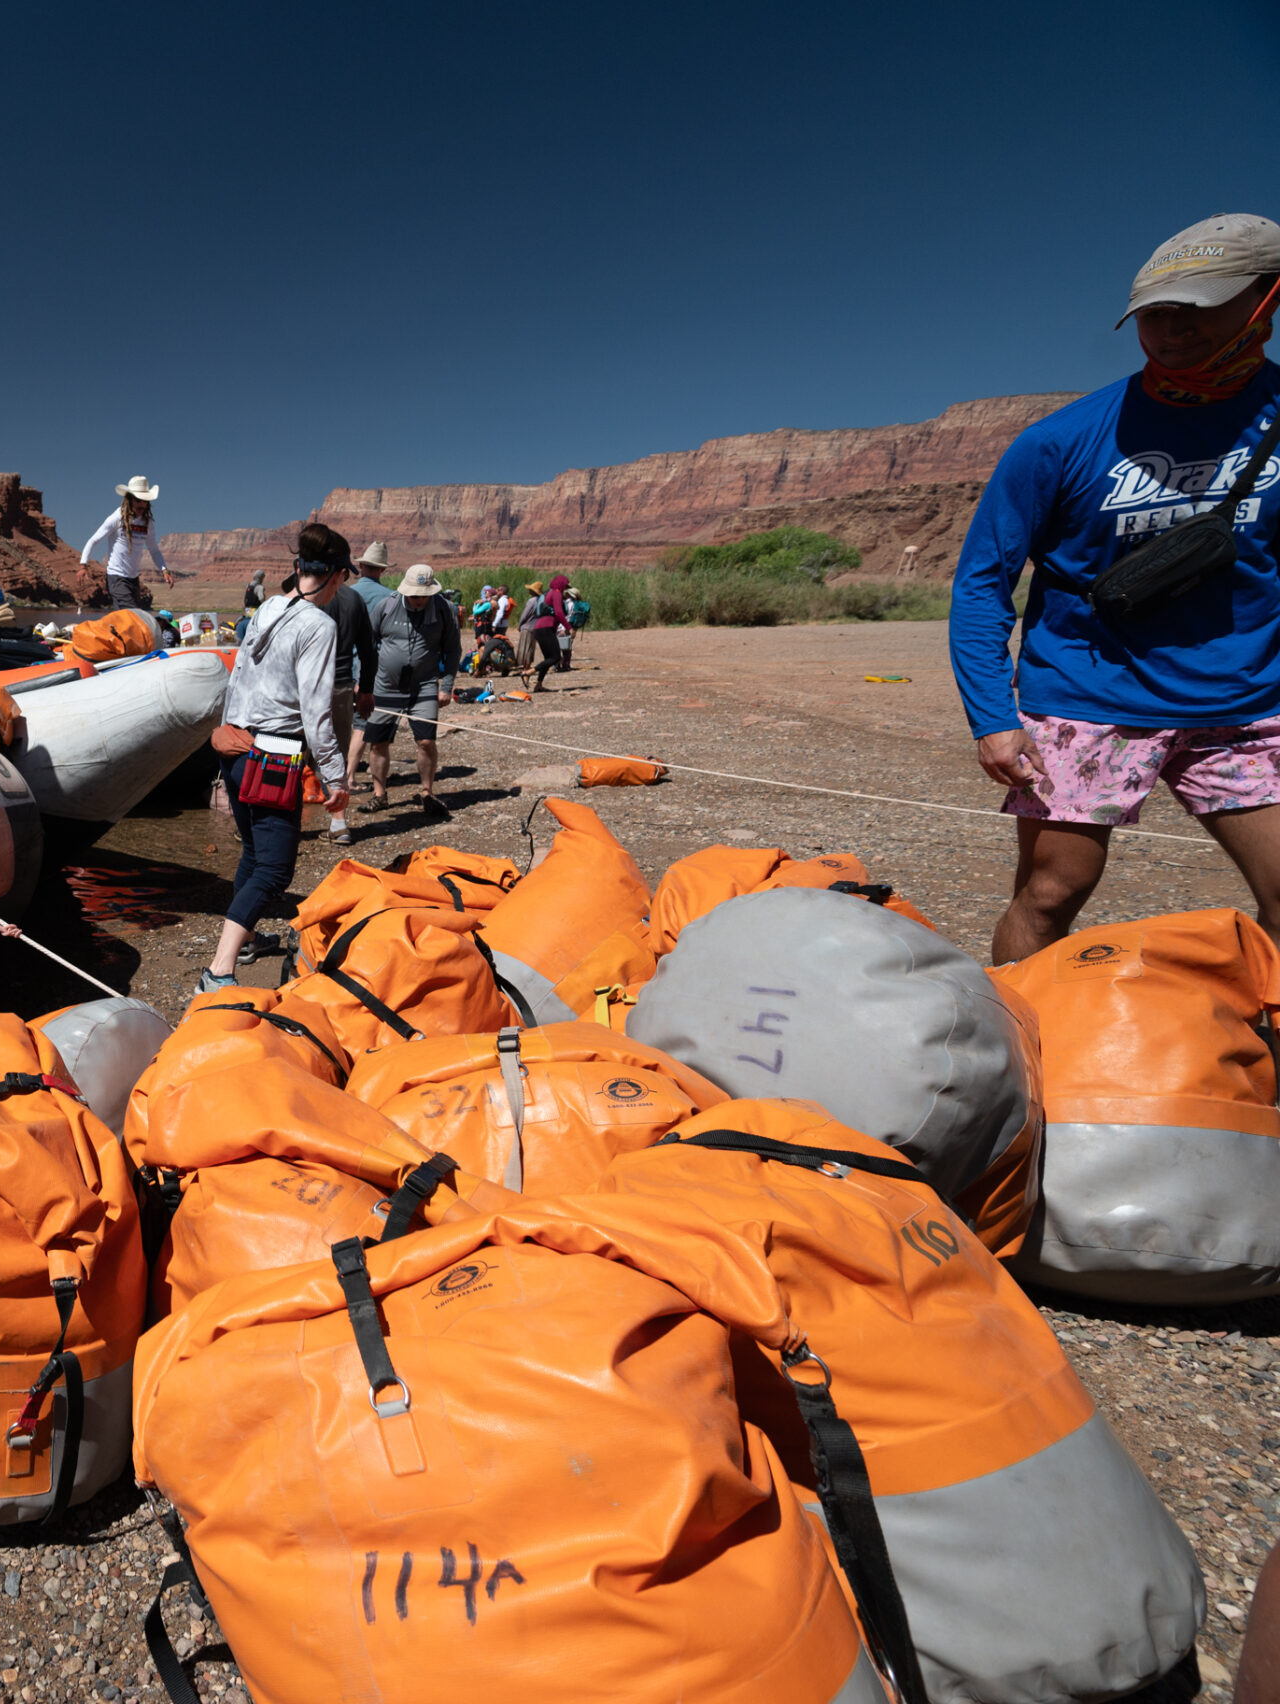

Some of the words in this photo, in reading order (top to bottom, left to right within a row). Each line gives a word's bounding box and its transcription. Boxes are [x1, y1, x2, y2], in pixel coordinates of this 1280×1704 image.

[1148, 245, 1225, 272] AUGUSTANA
[1100, 446, 1280, 512] Drake
[1123, 501, 1251, 534] RELS
[734, 985, 797, 1075] 147
